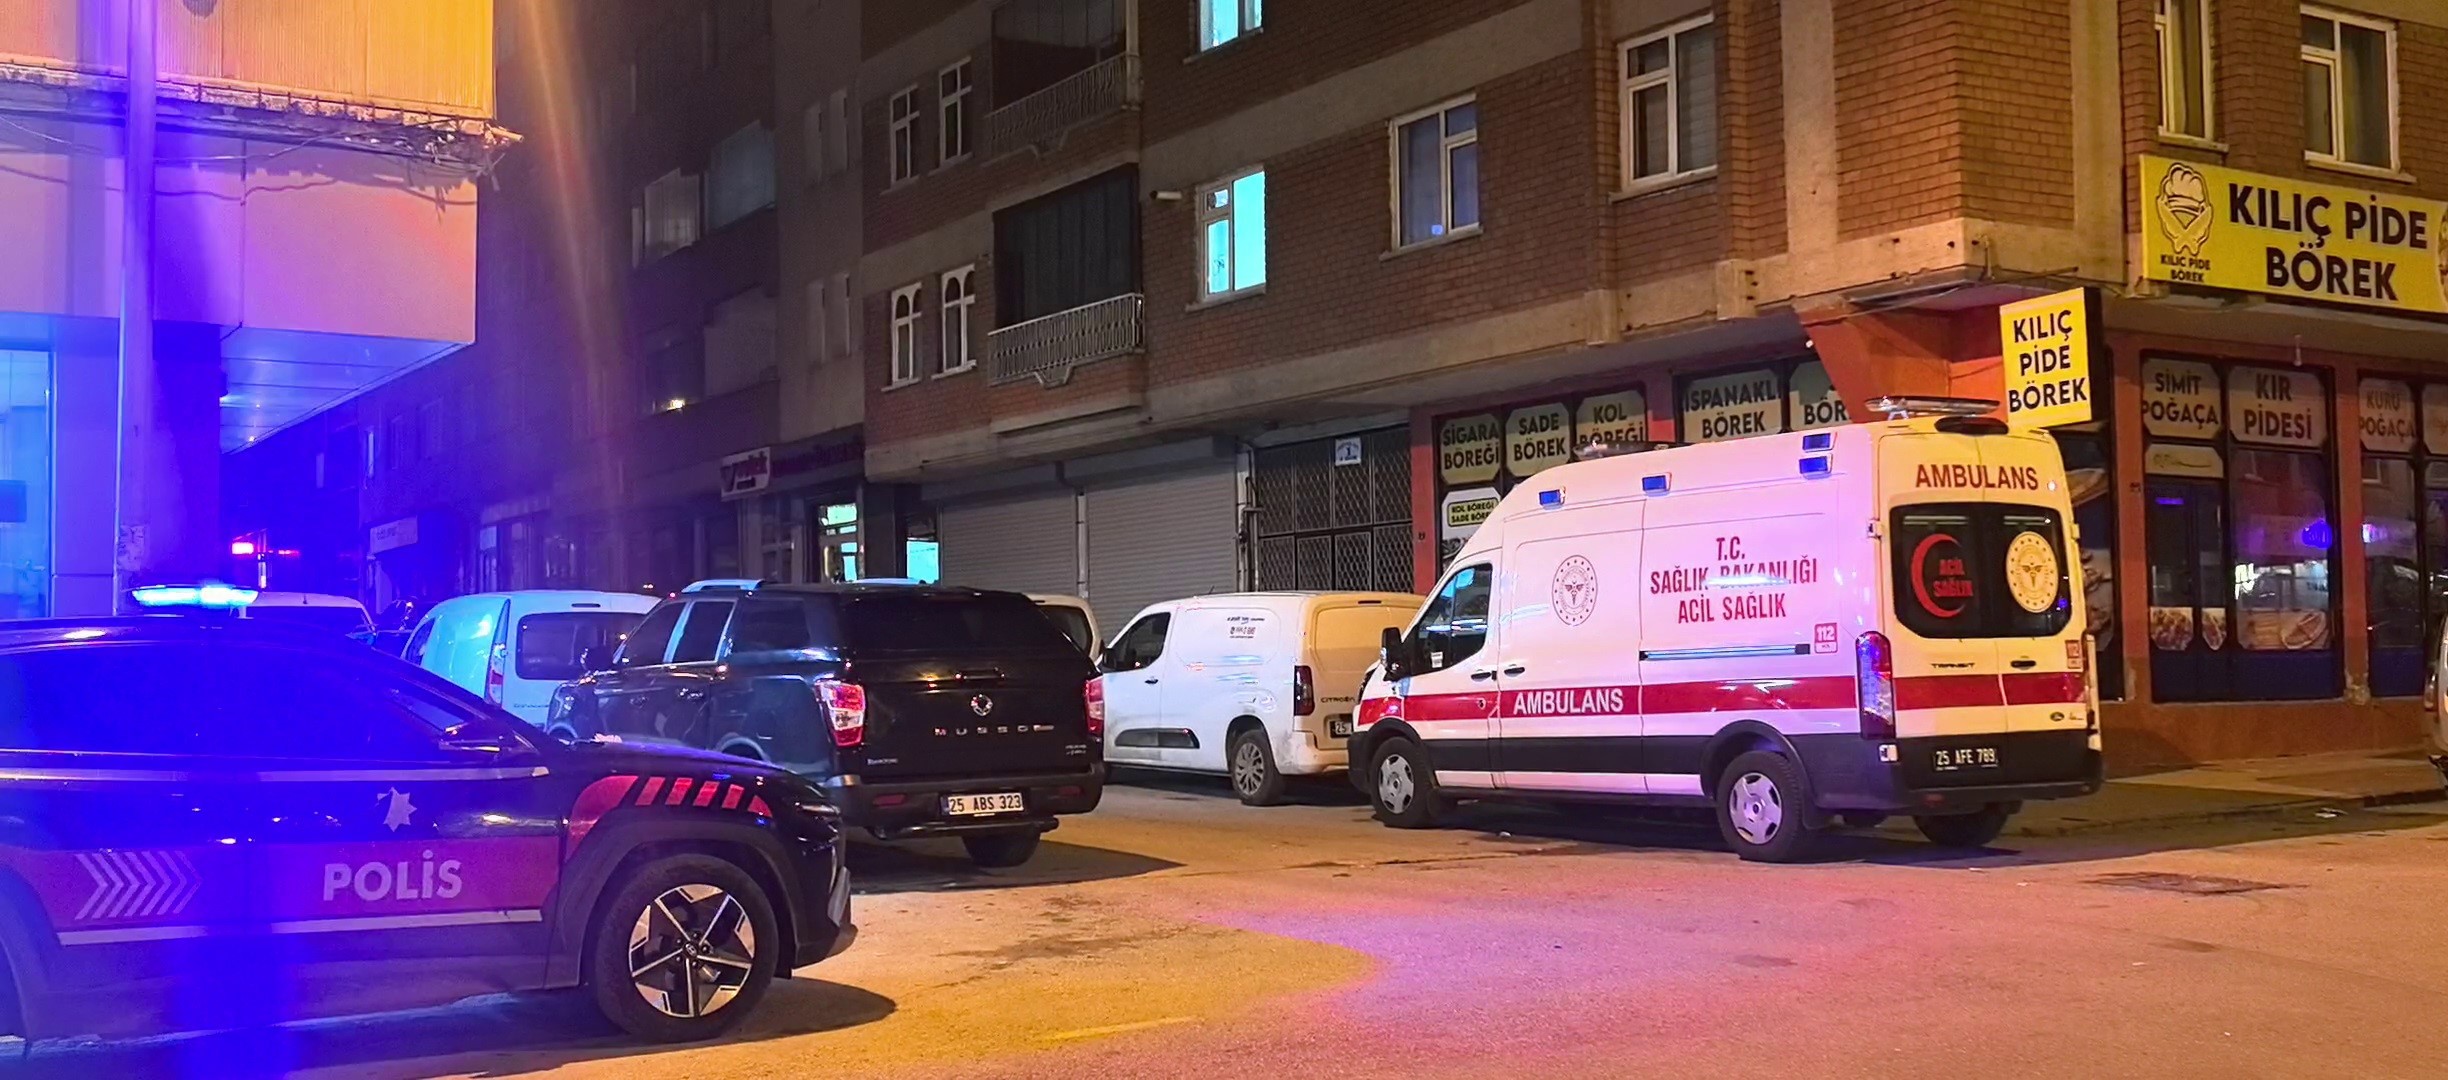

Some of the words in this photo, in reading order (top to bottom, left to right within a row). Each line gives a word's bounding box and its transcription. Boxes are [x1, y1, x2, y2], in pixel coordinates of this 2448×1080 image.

[2229, 183, 2332, 248] KILIÇ
[2345, 195, 2427, 249] PİDE
[2266, 240, 2398, 301] BÖREK
[2014, 310, 2073, 343] KILIÇ
[2020, 345, 2071, 376] PİDE
[1686, 379, 1782, 412] ISPANAKLI
[2008, 377, 2087, 412] BÖREK
[2155, 369, 2201, 395] SİMİT
[2256, 373, 2292, 401] KIR
[1593, 403, 1627, 424] KOL
[1804, 397, 1851, 425] BÖR
[2141, 397, 2218, 430] POĞAÇA
[2367, 389, 2400, 411] KURU
[1442, 422, 1499, 447] SİGARA
[1518, 412, 1560, 435] SADE
[1702, 411, 1765, 439] BÖREK
[2243, 408, 2312, 440] PİDESİ
[2359, 413, 2415, 443] POĞAÇA
[1444, 443, 1500, 470] BÖREĞİ
[1513, 438, 1567, 462] BÖREK
[1915, 463, 2039, 491] AMBULANS
[1451, 514, 1470, 524] SADE
[1716, 536, 1746, 562] T.C.
[1650, 565, 1709, 595] SAĞLIK
[1678, 594, 1715, 625] ACİL
[1722, 591, 1787, 621] SAĞLIK
[1513, 688, 1624, 716] AMBULANS
[1936, 750, 1950, 766] 25
[950, 798, 965, 813] 25
[973, 796, 995, 812] ABS
[999, 794, 1022, 810] 323
[322, 850, 464, 901] POLİS
